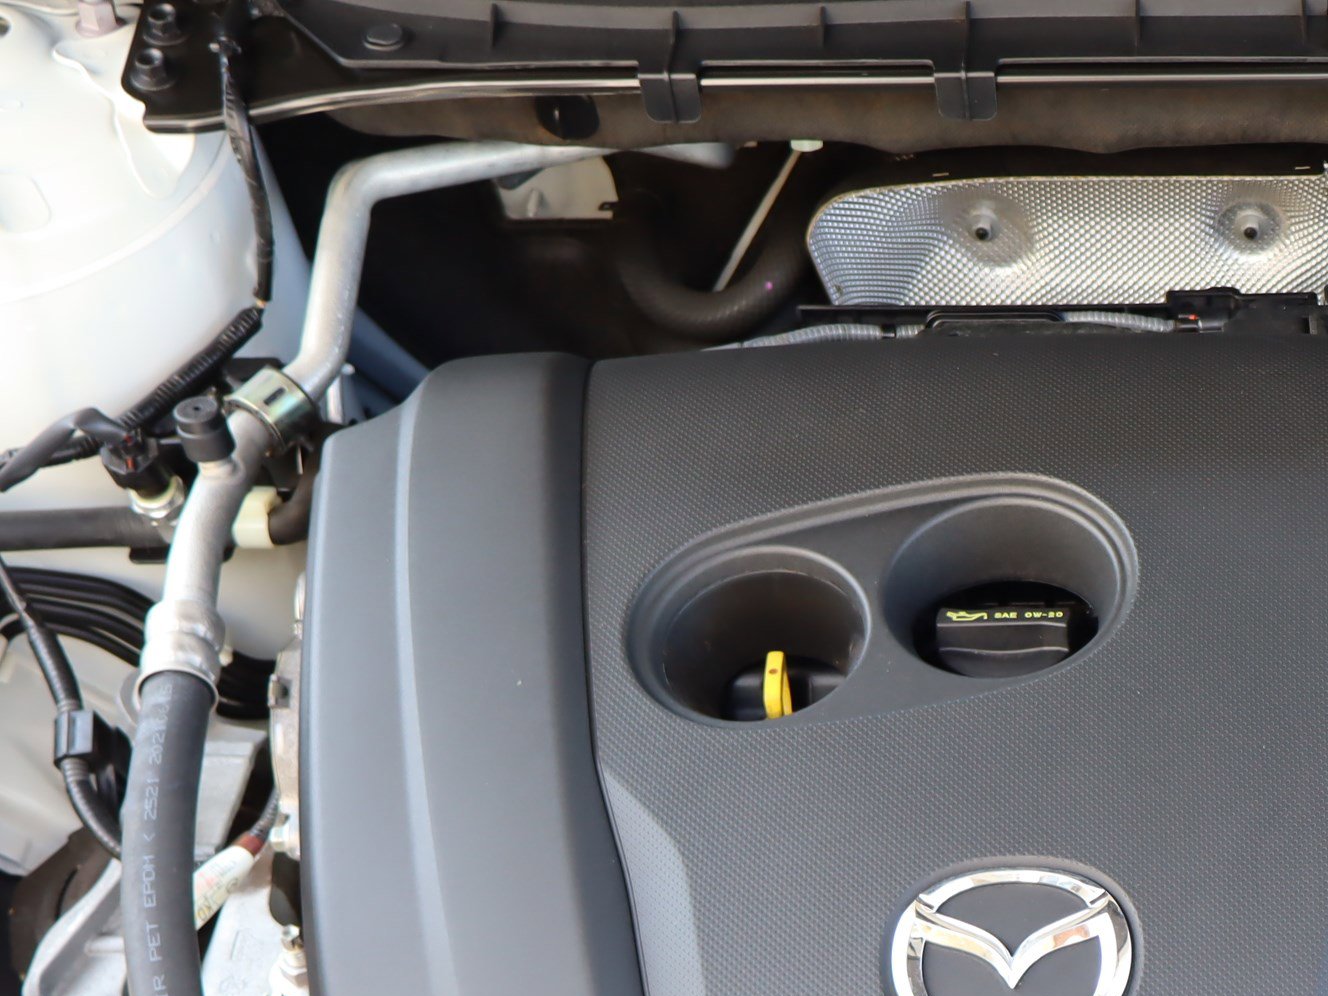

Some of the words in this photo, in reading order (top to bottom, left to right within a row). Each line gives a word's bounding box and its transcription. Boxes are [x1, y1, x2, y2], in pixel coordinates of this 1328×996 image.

[994, 611, 1018, 619] SAE
[1024, 610, 1064, 619] 0W-20
[144, 775, 159, 820] 2521
[144, 855, 157, 908] EPDM
[149, 922, 163, 964] PET
